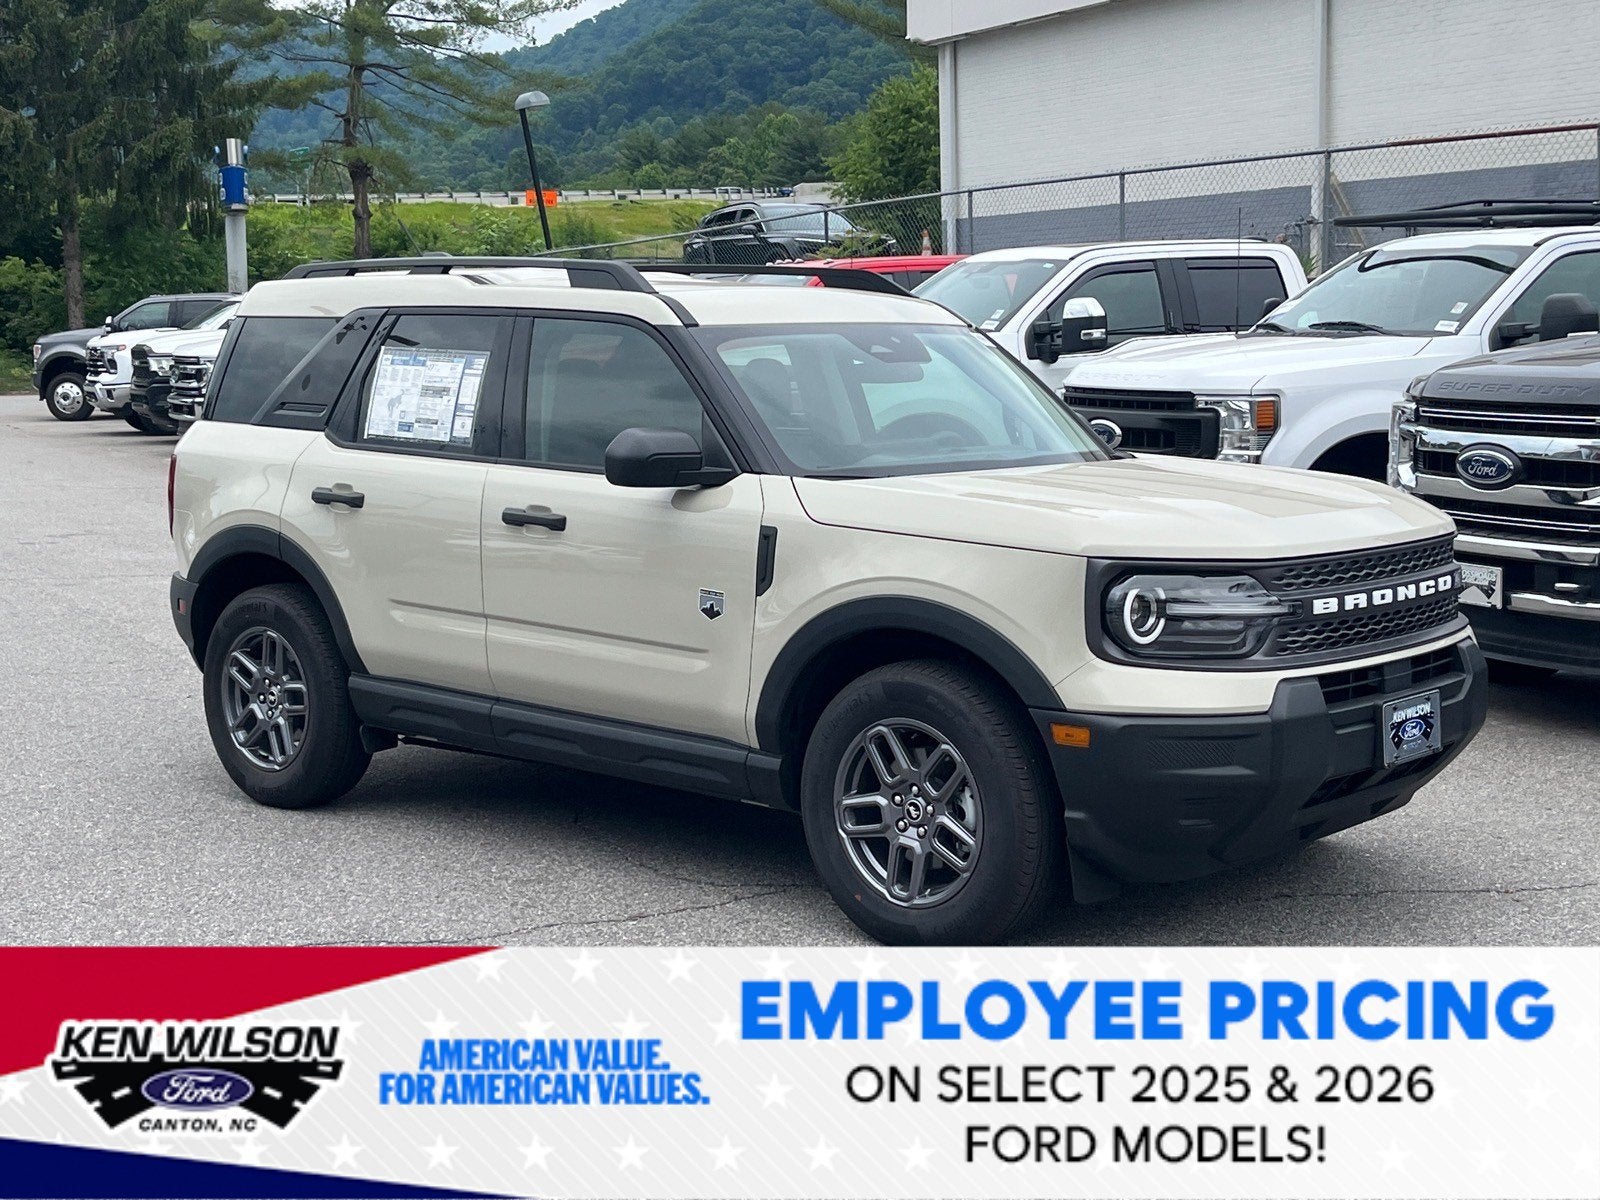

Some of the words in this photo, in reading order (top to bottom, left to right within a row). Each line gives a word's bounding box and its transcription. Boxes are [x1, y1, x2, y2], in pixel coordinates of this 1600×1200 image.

[1438, 381, 1512, 394] SUPER
[1517, 384, 1592, 397] DUTY
[1468, 455, 1499, 477] Ford
[1312, 574, 1452, 615] BRONCO
[1403, 722, 1421, 738] Ford
